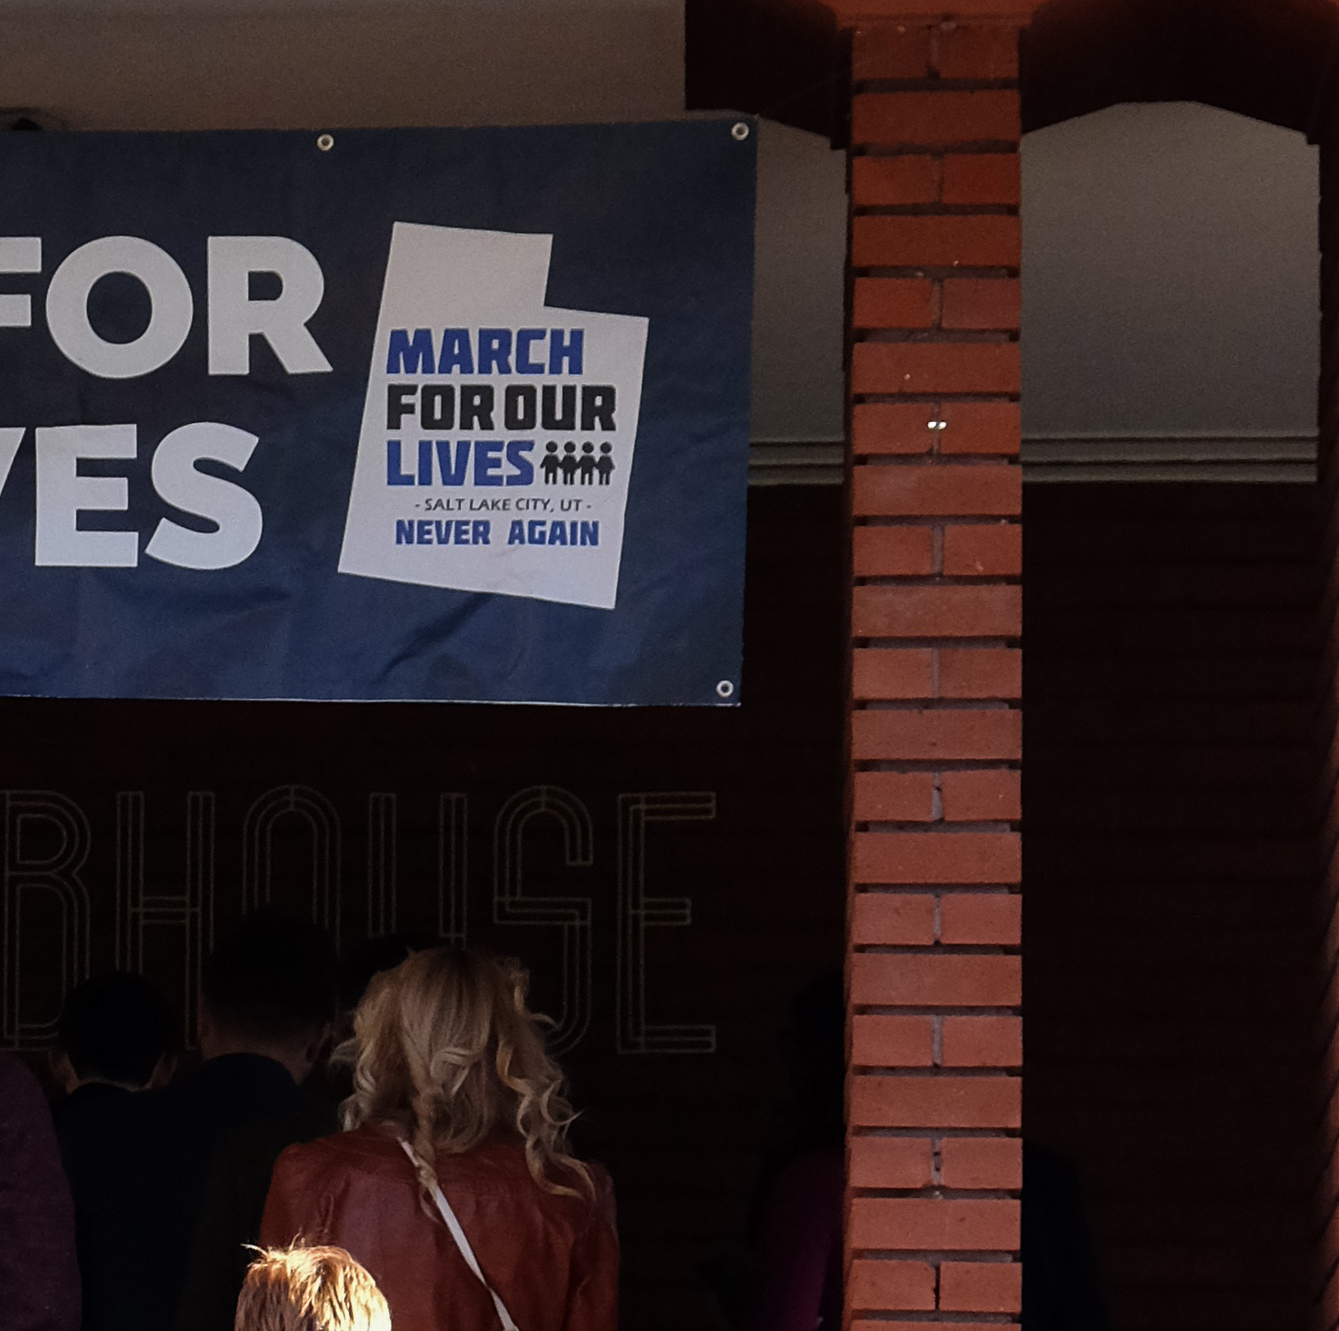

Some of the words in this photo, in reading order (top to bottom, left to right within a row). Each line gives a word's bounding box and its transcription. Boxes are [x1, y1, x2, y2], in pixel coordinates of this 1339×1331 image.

[385, 328, 585, 375] MARCH
[386, 383, 495, 431] FOR
[503, 383, 617, 432] OUR
[386, 439, 536, 487] LIVES
[424, 498, 465, 511] SALT
[469, 498, 510, 511] LAKE
[515, 498, 555, 513] CITY,
[560, 499, 583, 512] UT
[395, 519, 491, 545] NEVER
[507, 519, 599, 546] AGAIN
